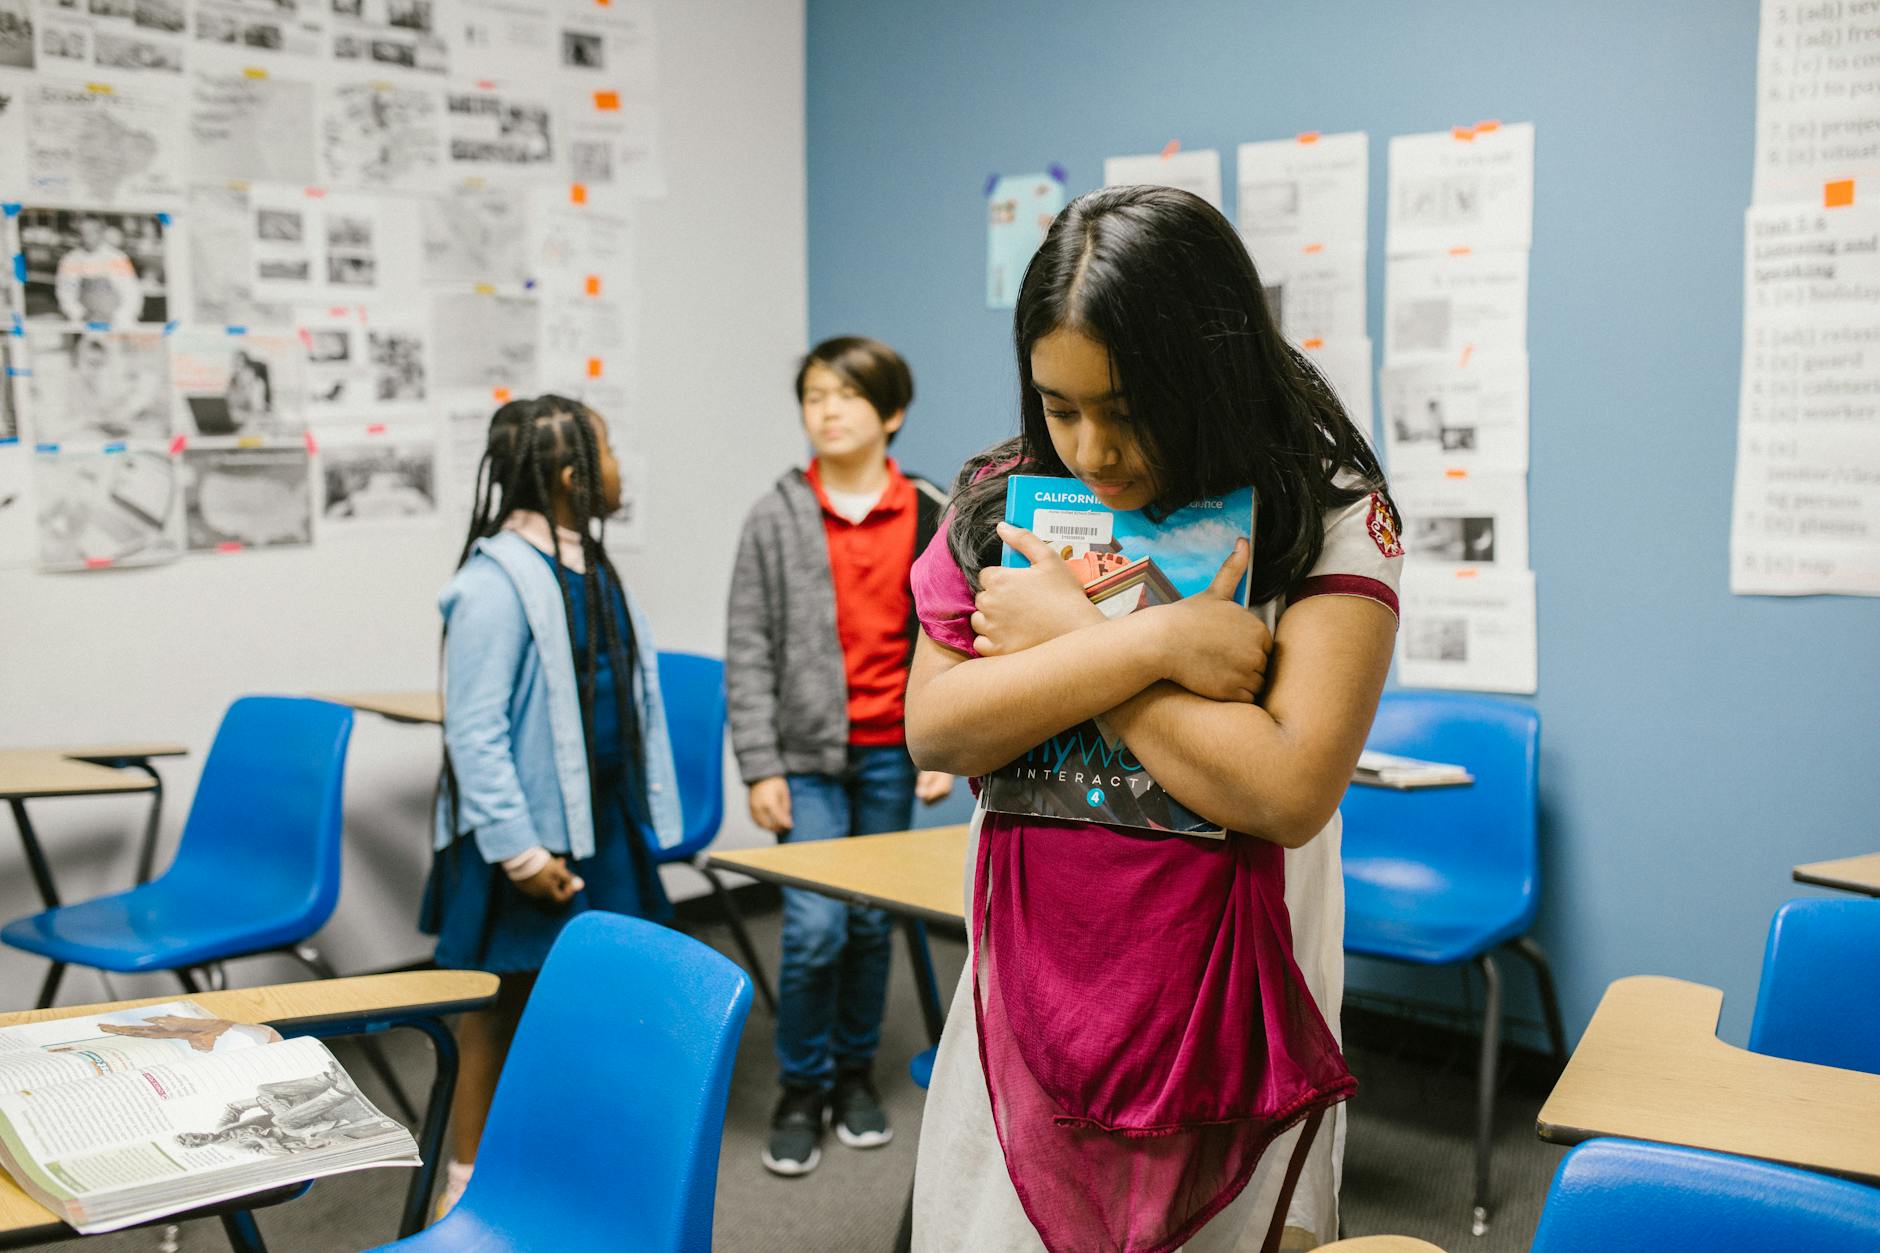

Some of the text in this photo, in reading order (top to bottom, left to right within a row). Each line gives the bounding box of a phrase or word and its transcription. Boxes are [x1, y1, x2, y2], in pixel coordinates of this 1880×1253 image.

[1034, 491, 1102, 504] CALIFORNI
[1016, 767, 1166, 793] INTERACTI
[1091, 791, 1100, 804] 4
